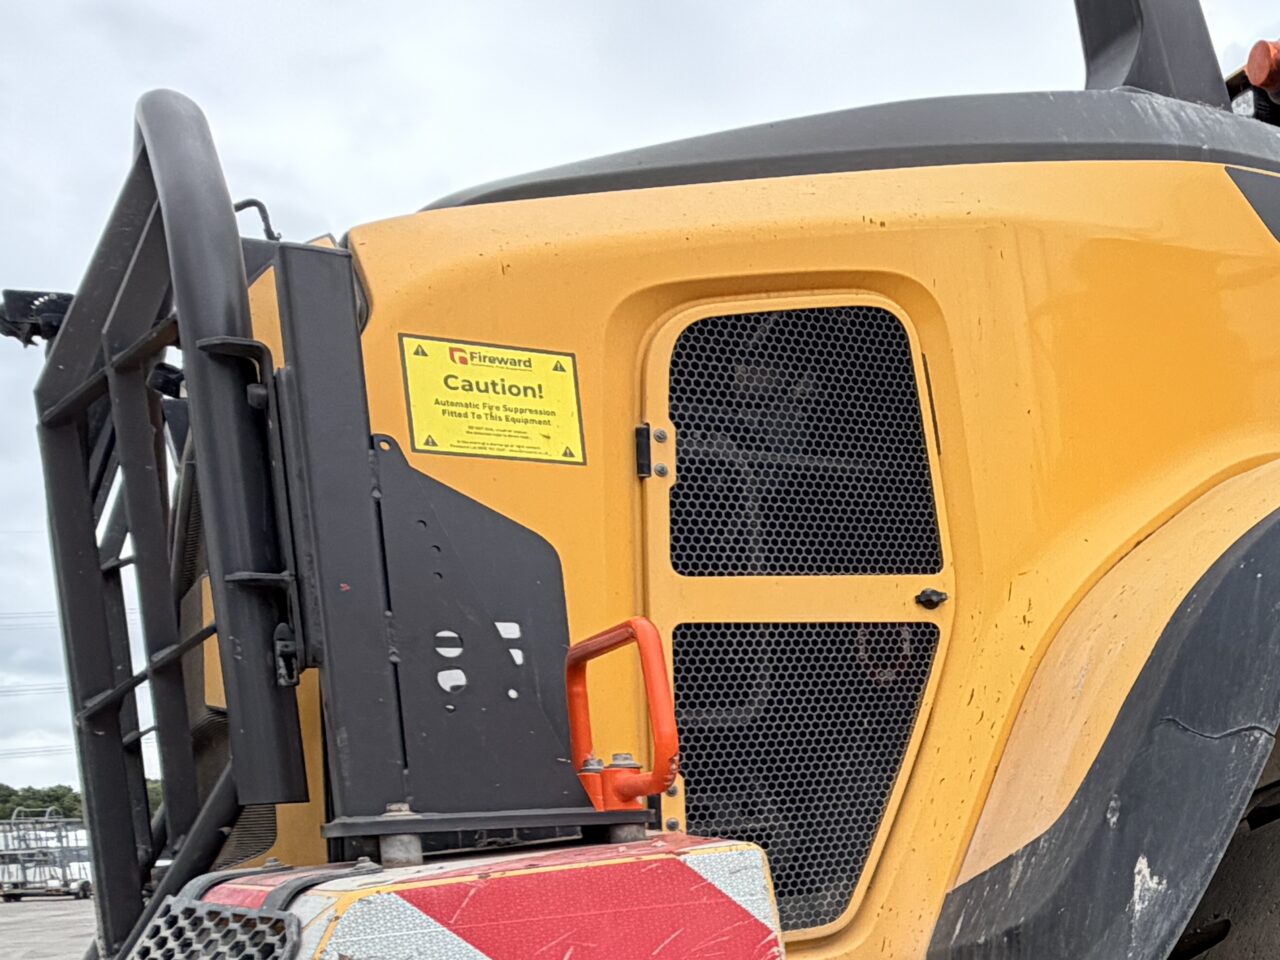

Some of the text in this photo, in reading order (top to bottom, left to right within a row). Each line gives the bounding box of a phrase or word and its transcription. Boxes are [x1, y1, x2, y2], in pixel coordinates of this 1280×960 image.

[469, 351, 533, 369] Fireward
[443, 374, 545, 399] Caution!
[434, 398, 557, 417] Automatic Fire Suppression
[441, 409, 552, 426] Fitted To This Equipment
